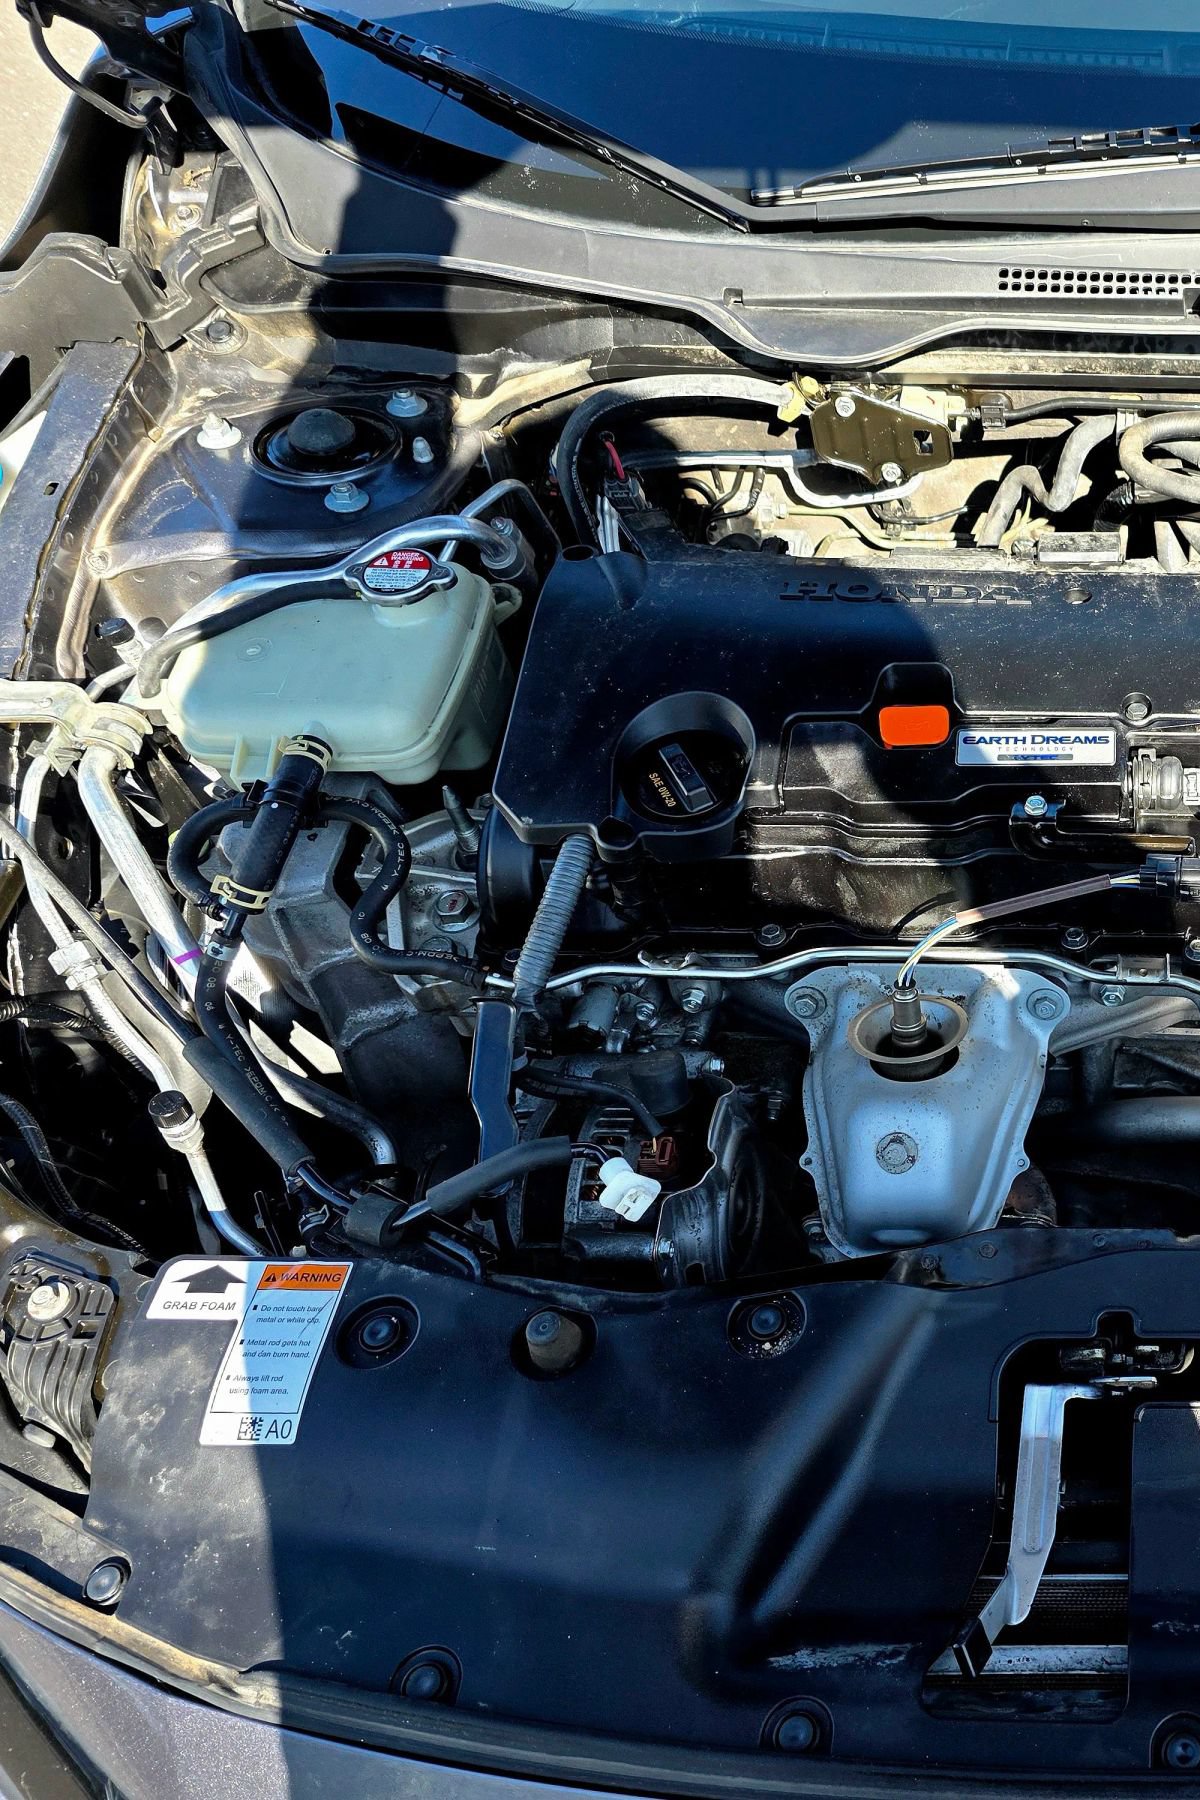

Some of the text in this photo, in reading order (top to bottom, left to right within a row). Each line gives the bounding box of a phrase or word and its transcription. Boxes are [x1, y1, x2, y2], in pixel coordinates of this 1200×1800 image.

[779, 580, 1033, 605] HONDA
[962, 734, 1110, 745] EARTH DREAMS
[648, 772, 677, 807] SAE 0W-20
[225, 1033, 246, 1062] Y-TEC
[280, 1272, 342, 1283] WARNING
[162, 1300, 237, 1311] GRAB FOAM
[260, 1304, 272, 1312] Do
[272, 1304, 285, 1312] not
[286, 1304, 306, 1312] touch
[281, 1340, 298, 1348] gets
[233, 1374, 284, 1383] Always lift rod
[229, 1386, 289, 1396] using foam area.
[264, 1419, 293, 1439] A0
